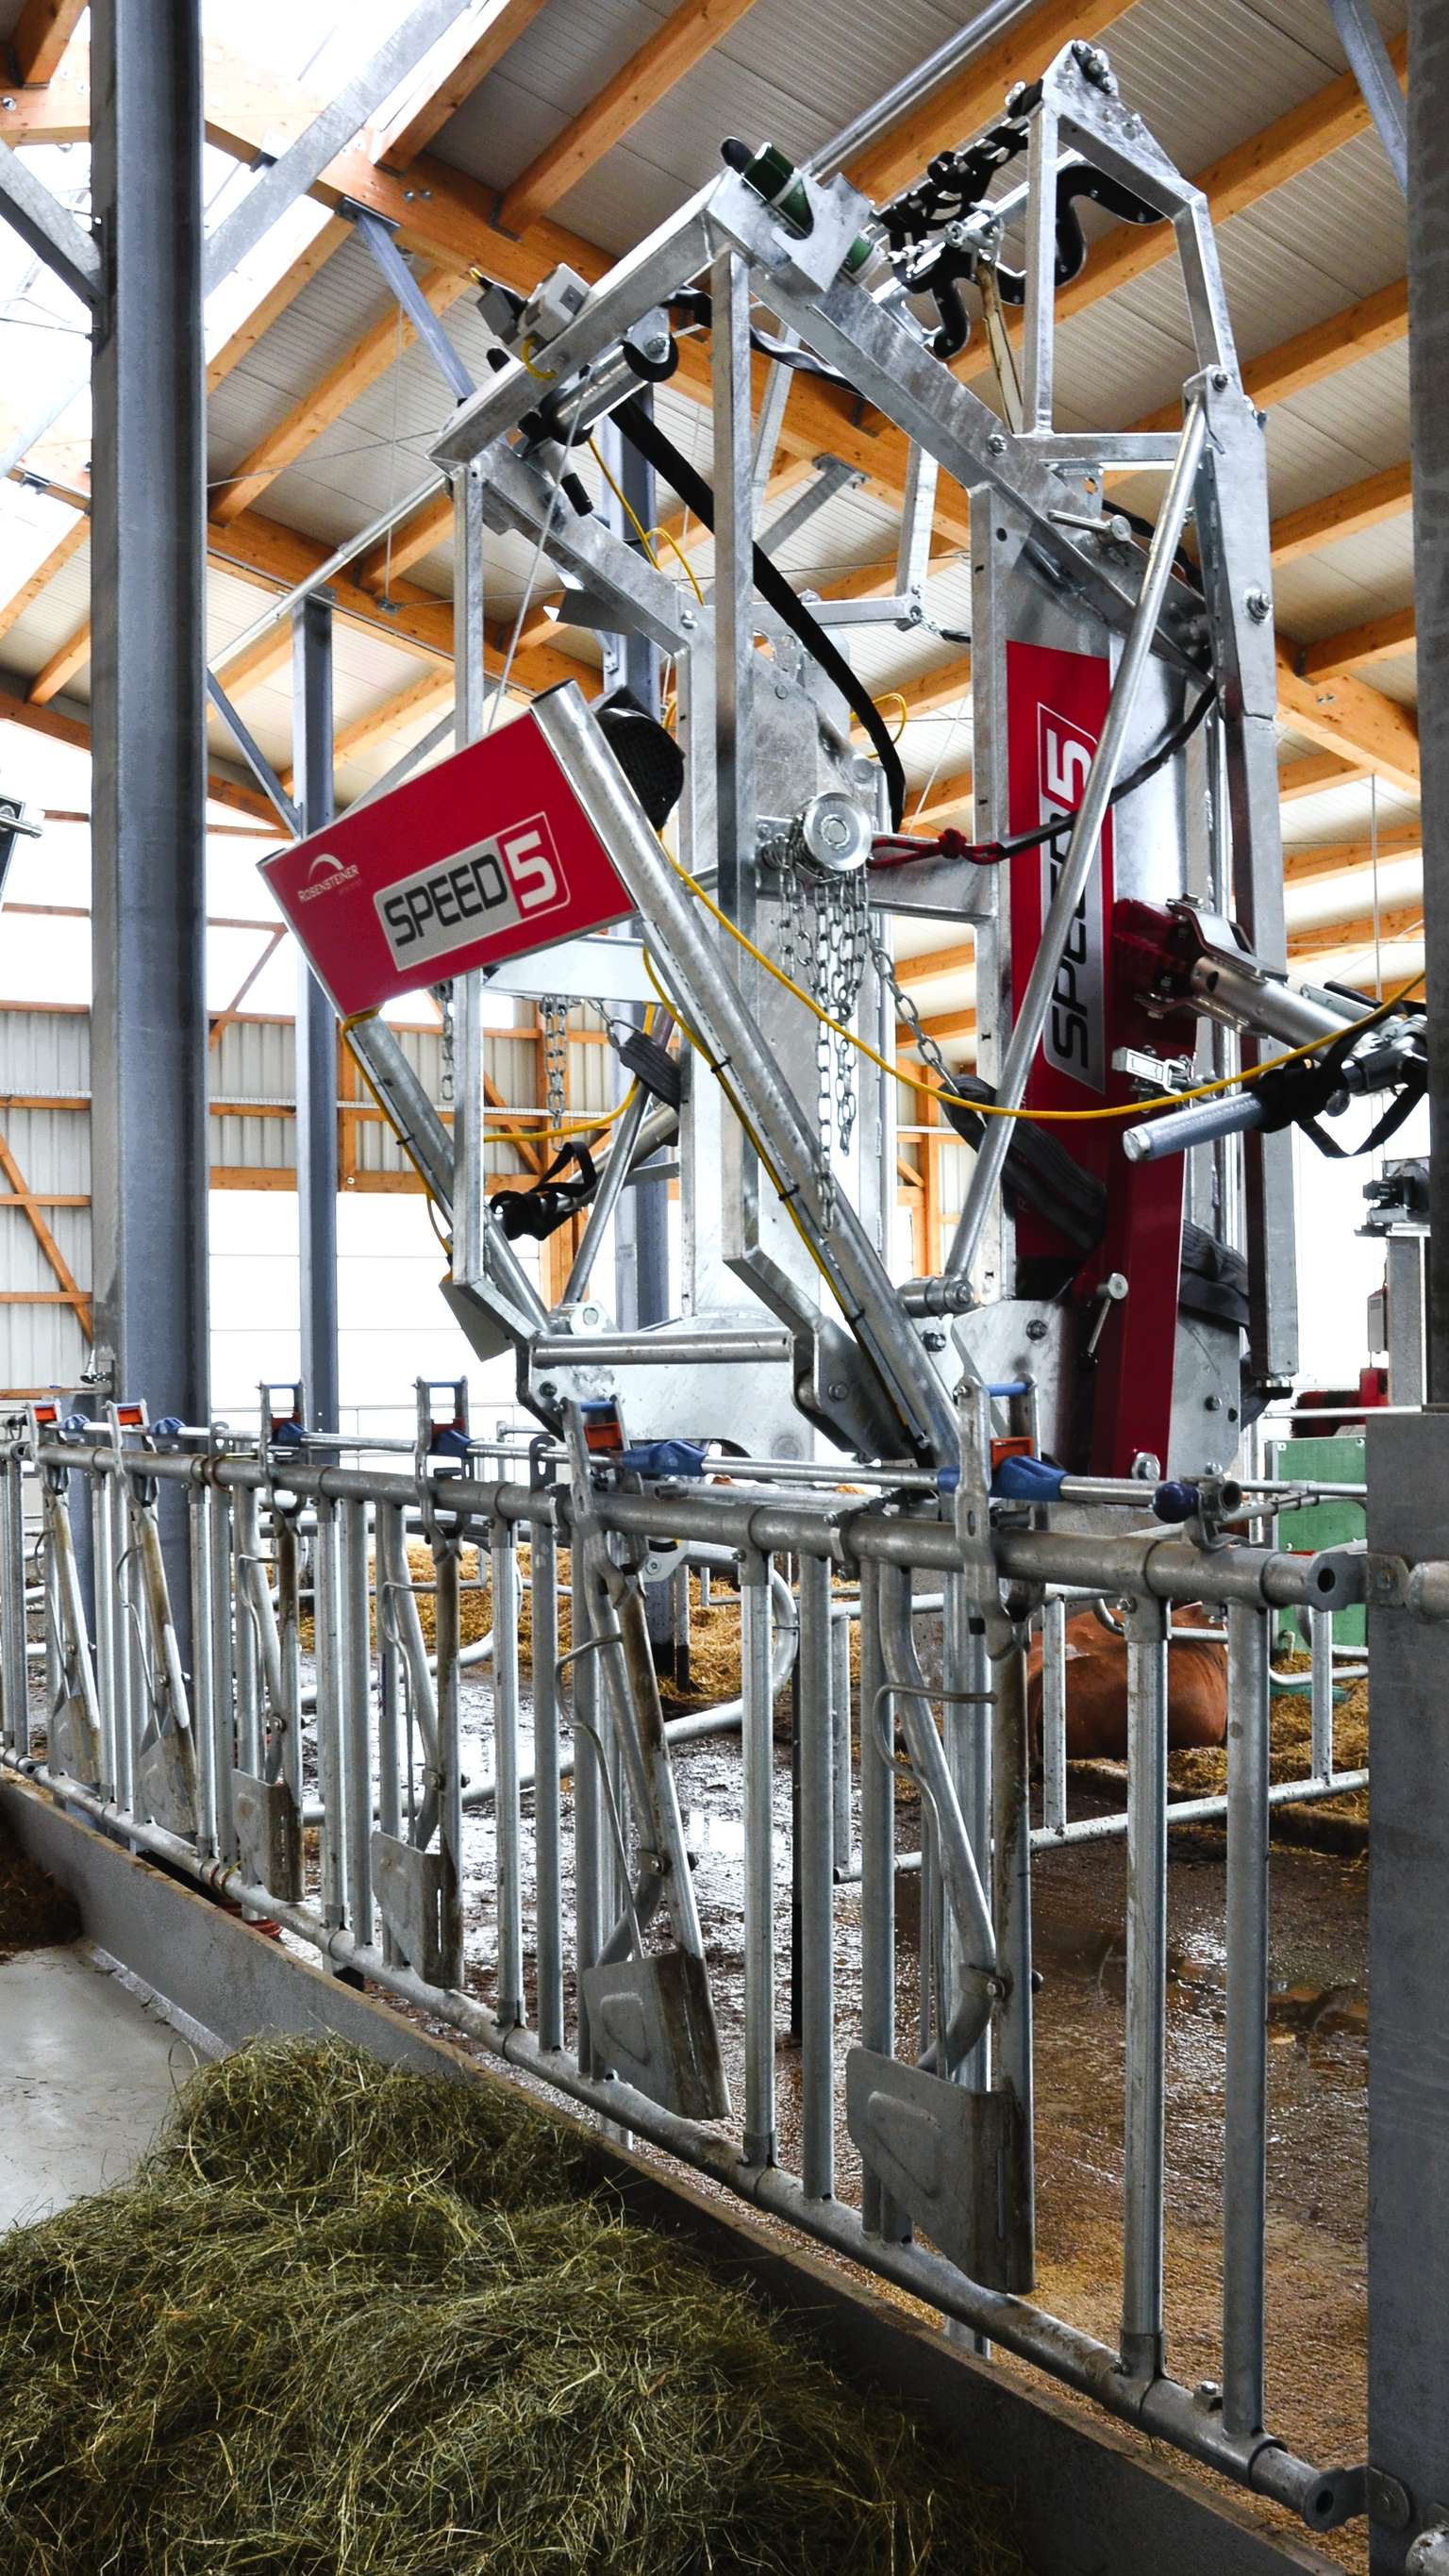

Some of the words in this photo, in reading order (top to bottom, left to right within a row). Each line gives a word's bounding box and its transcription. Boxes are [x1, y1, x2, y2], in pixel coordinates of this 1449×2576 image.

[1046, 728, 1092, 804] 5
[383, 854, 508, 947] SPEED
[504, 829, 558, 909] 5
